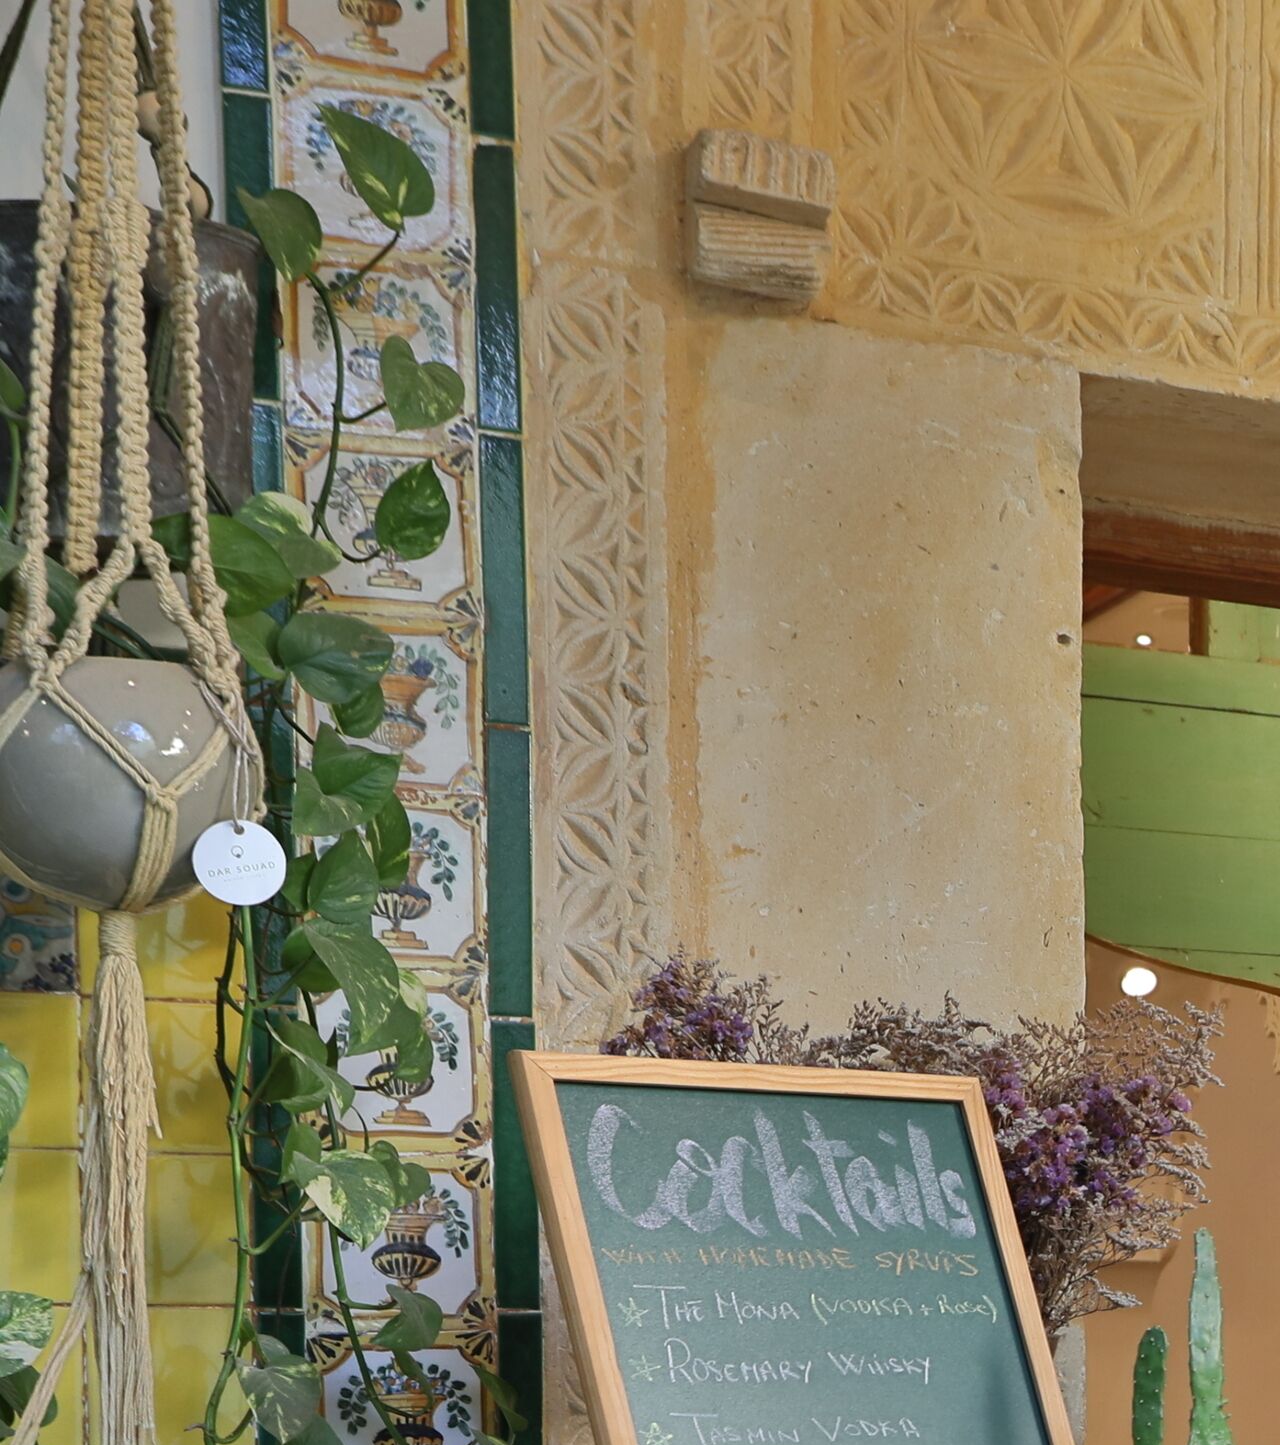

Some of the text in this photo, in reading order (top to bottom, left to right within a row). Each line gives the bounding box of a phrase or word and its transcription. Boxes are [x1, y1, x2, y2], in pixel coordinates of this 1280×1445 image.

[207, 867, 232, 878] DAR
[236, 861, 276, 874] SOUAD
[586, 1103, 977, 1239] Cocktails
